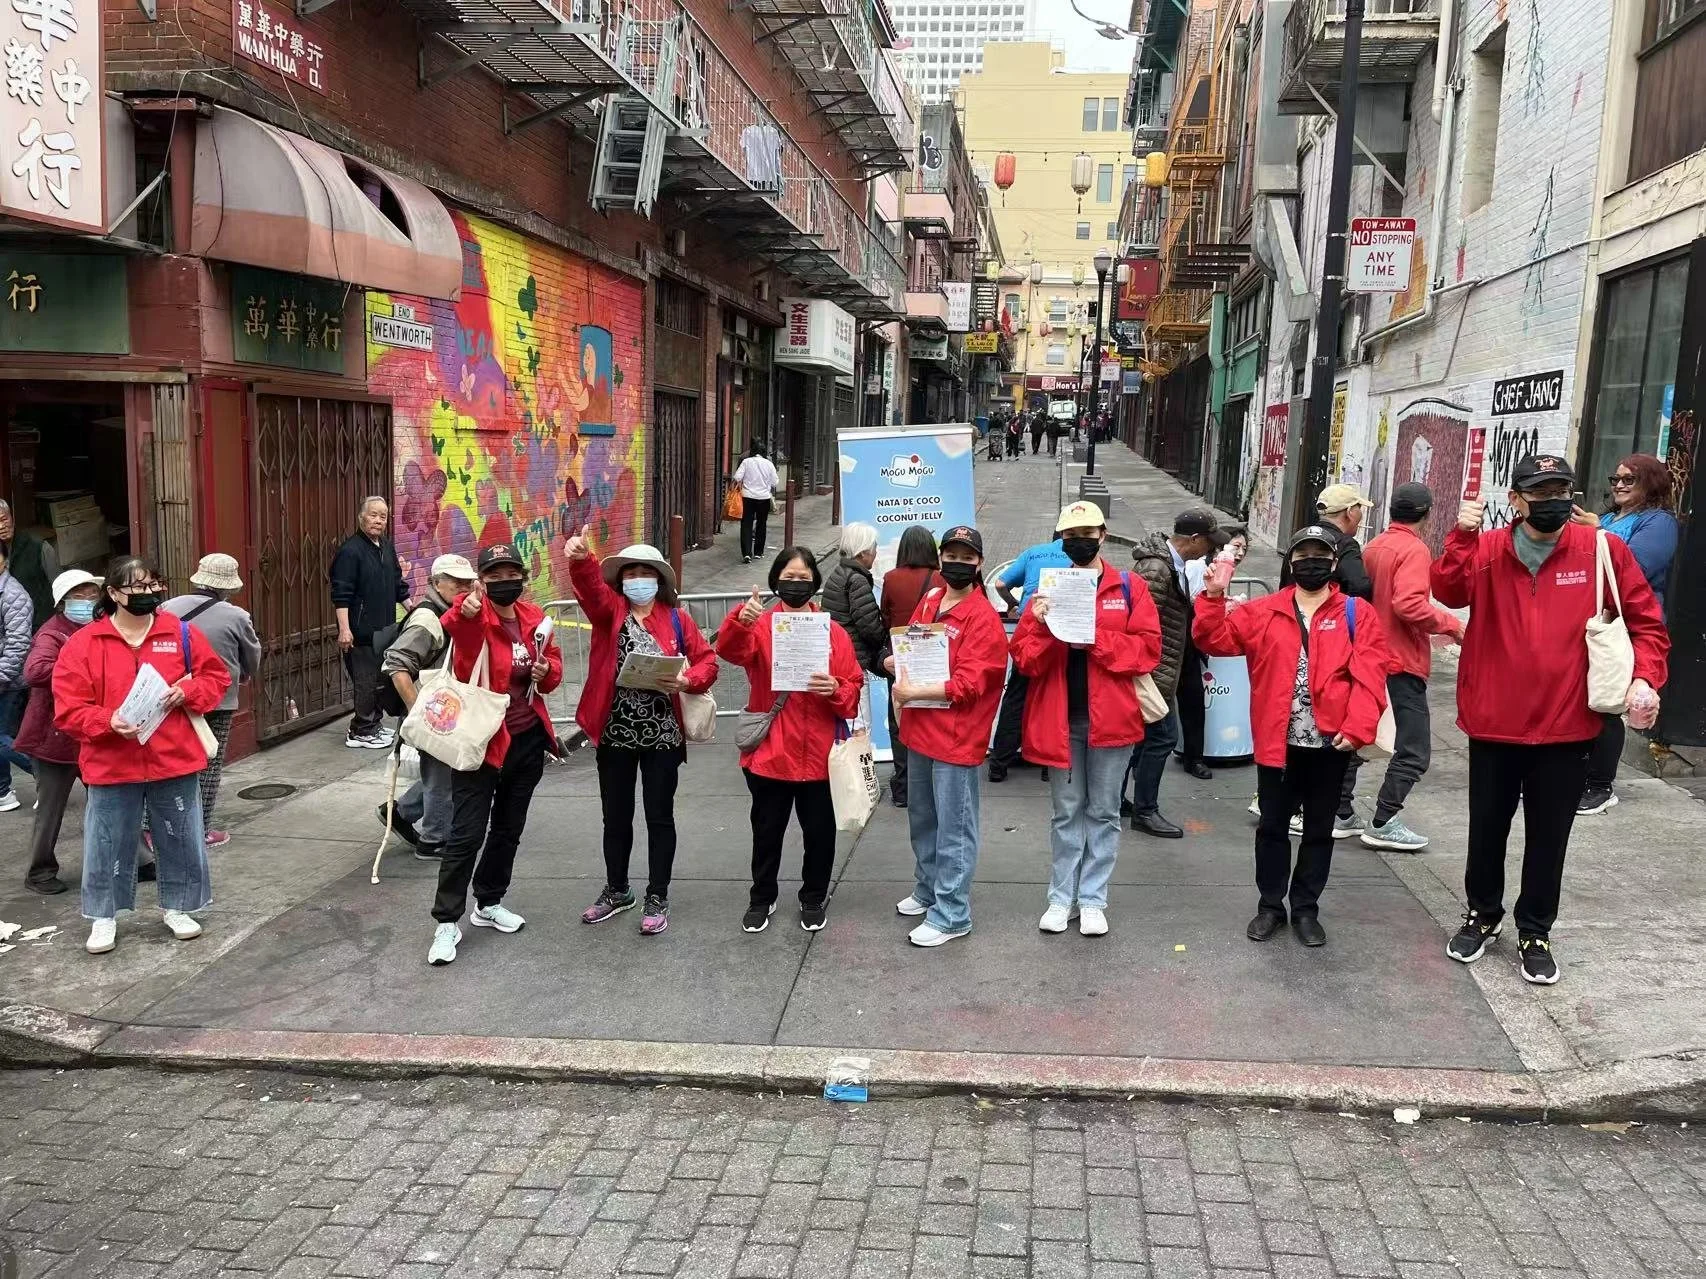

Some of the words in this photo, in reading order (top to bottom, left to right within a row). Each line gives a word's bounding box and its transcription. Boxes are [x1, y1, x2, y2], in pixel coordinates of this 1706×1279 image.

[238, 30, 269, 64] WAN
[270, 46, 298, 78] HUA
[1361, 220, 1407, 230] TOW-AWAY
[1352, 230, 1370, 245] NO
[1372, 234, 1412, 245] STOPPING
[1366, 251, 1395, 263] ANY
[1364, 265, 1396, 276] TIME
[5, 269, 44, 313] 行
[398, 306, 411, 319] END
[789, 302, 809, 347] 文生玉器
[374, 321, 432, 346] WENTWORTH
[1495, 381, 1525, 413] CHEF
[877, 498, 900, 507] NATA
[902, 498, 914, 506] DE
[916, 496, 941, 505] COCO
[876, 513, 918, 523] COCONUT
[920, 512, 943, 521] JELLY
